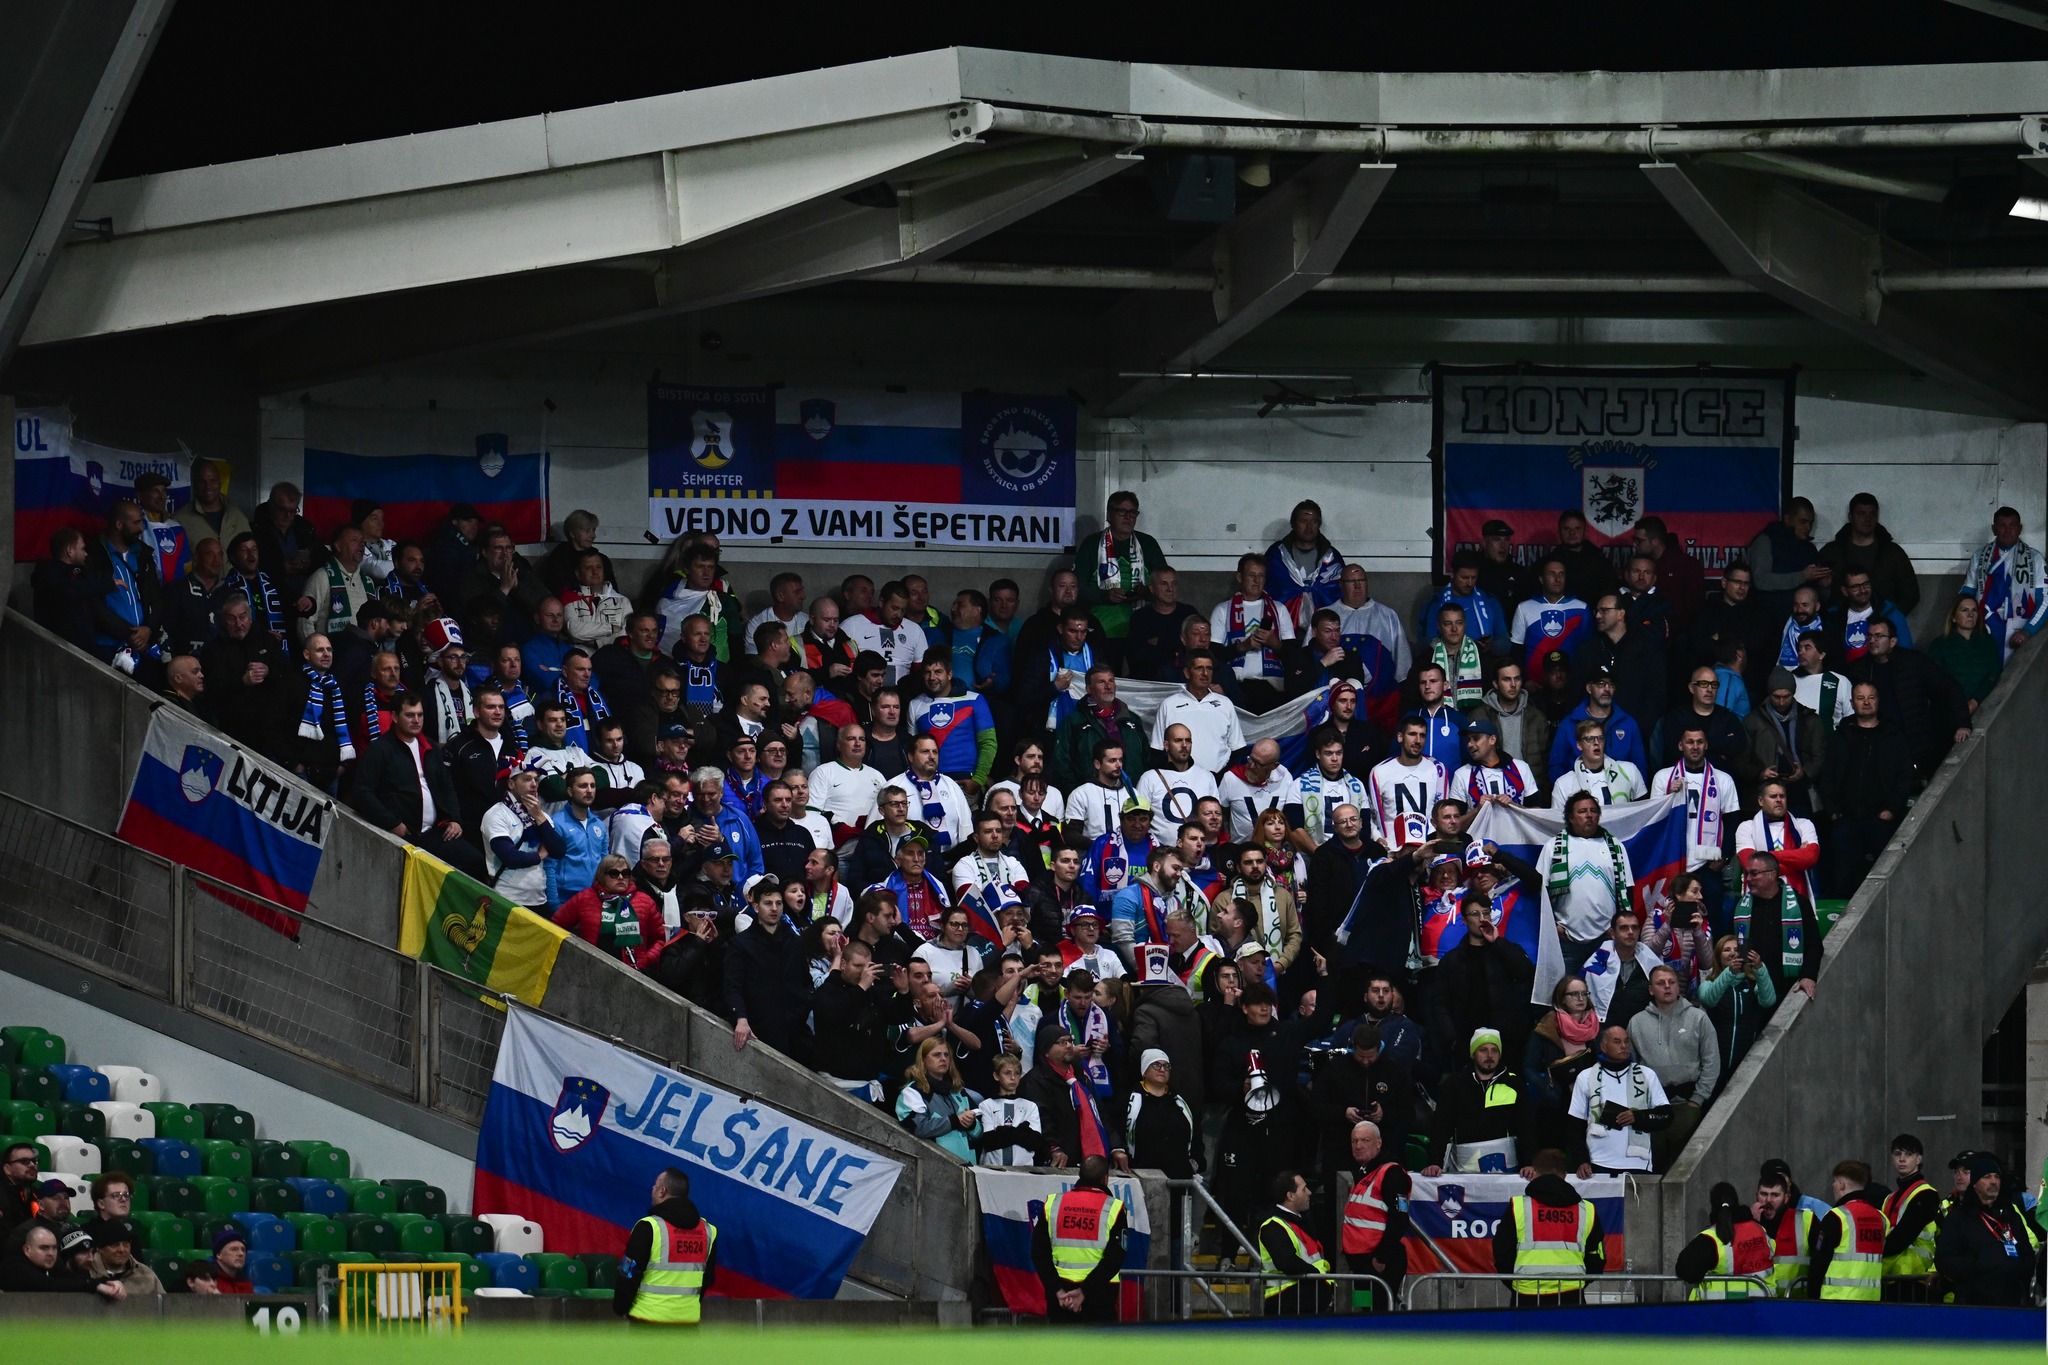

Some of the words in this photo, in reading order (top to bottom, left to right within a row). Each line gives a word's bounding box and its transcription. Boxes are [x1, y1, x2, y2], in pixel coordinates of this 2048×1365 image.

[1461, 386, 1766, 437] KONJICE
[682, 471, 743, 486] ŠEMPETER
[982, 458, 1019, 492] BISTRICA
[1022, 482, 1036, 492] OB
[1037, 459, 1058, 486] SOTLI
[665, 507, 770, 535] VEDNO
[781, 509, 798, 536] Z
[808, 509, 883, 537] VAMI
[893, 504, 1060, 544] ŠEPETRANI
[226, 754, 326, 845] LITIJA
[1162, 787, 1198, 823] O
[614, 1073, 870, 1216] JELŠANE
[1062, 1215, 1095, 1231] E5455
[1064, 1205, 1099, 1215] eventsec
[1537, 1210, 1574, 1225] E4953
[677, 1241, 703, 1254] E5624
